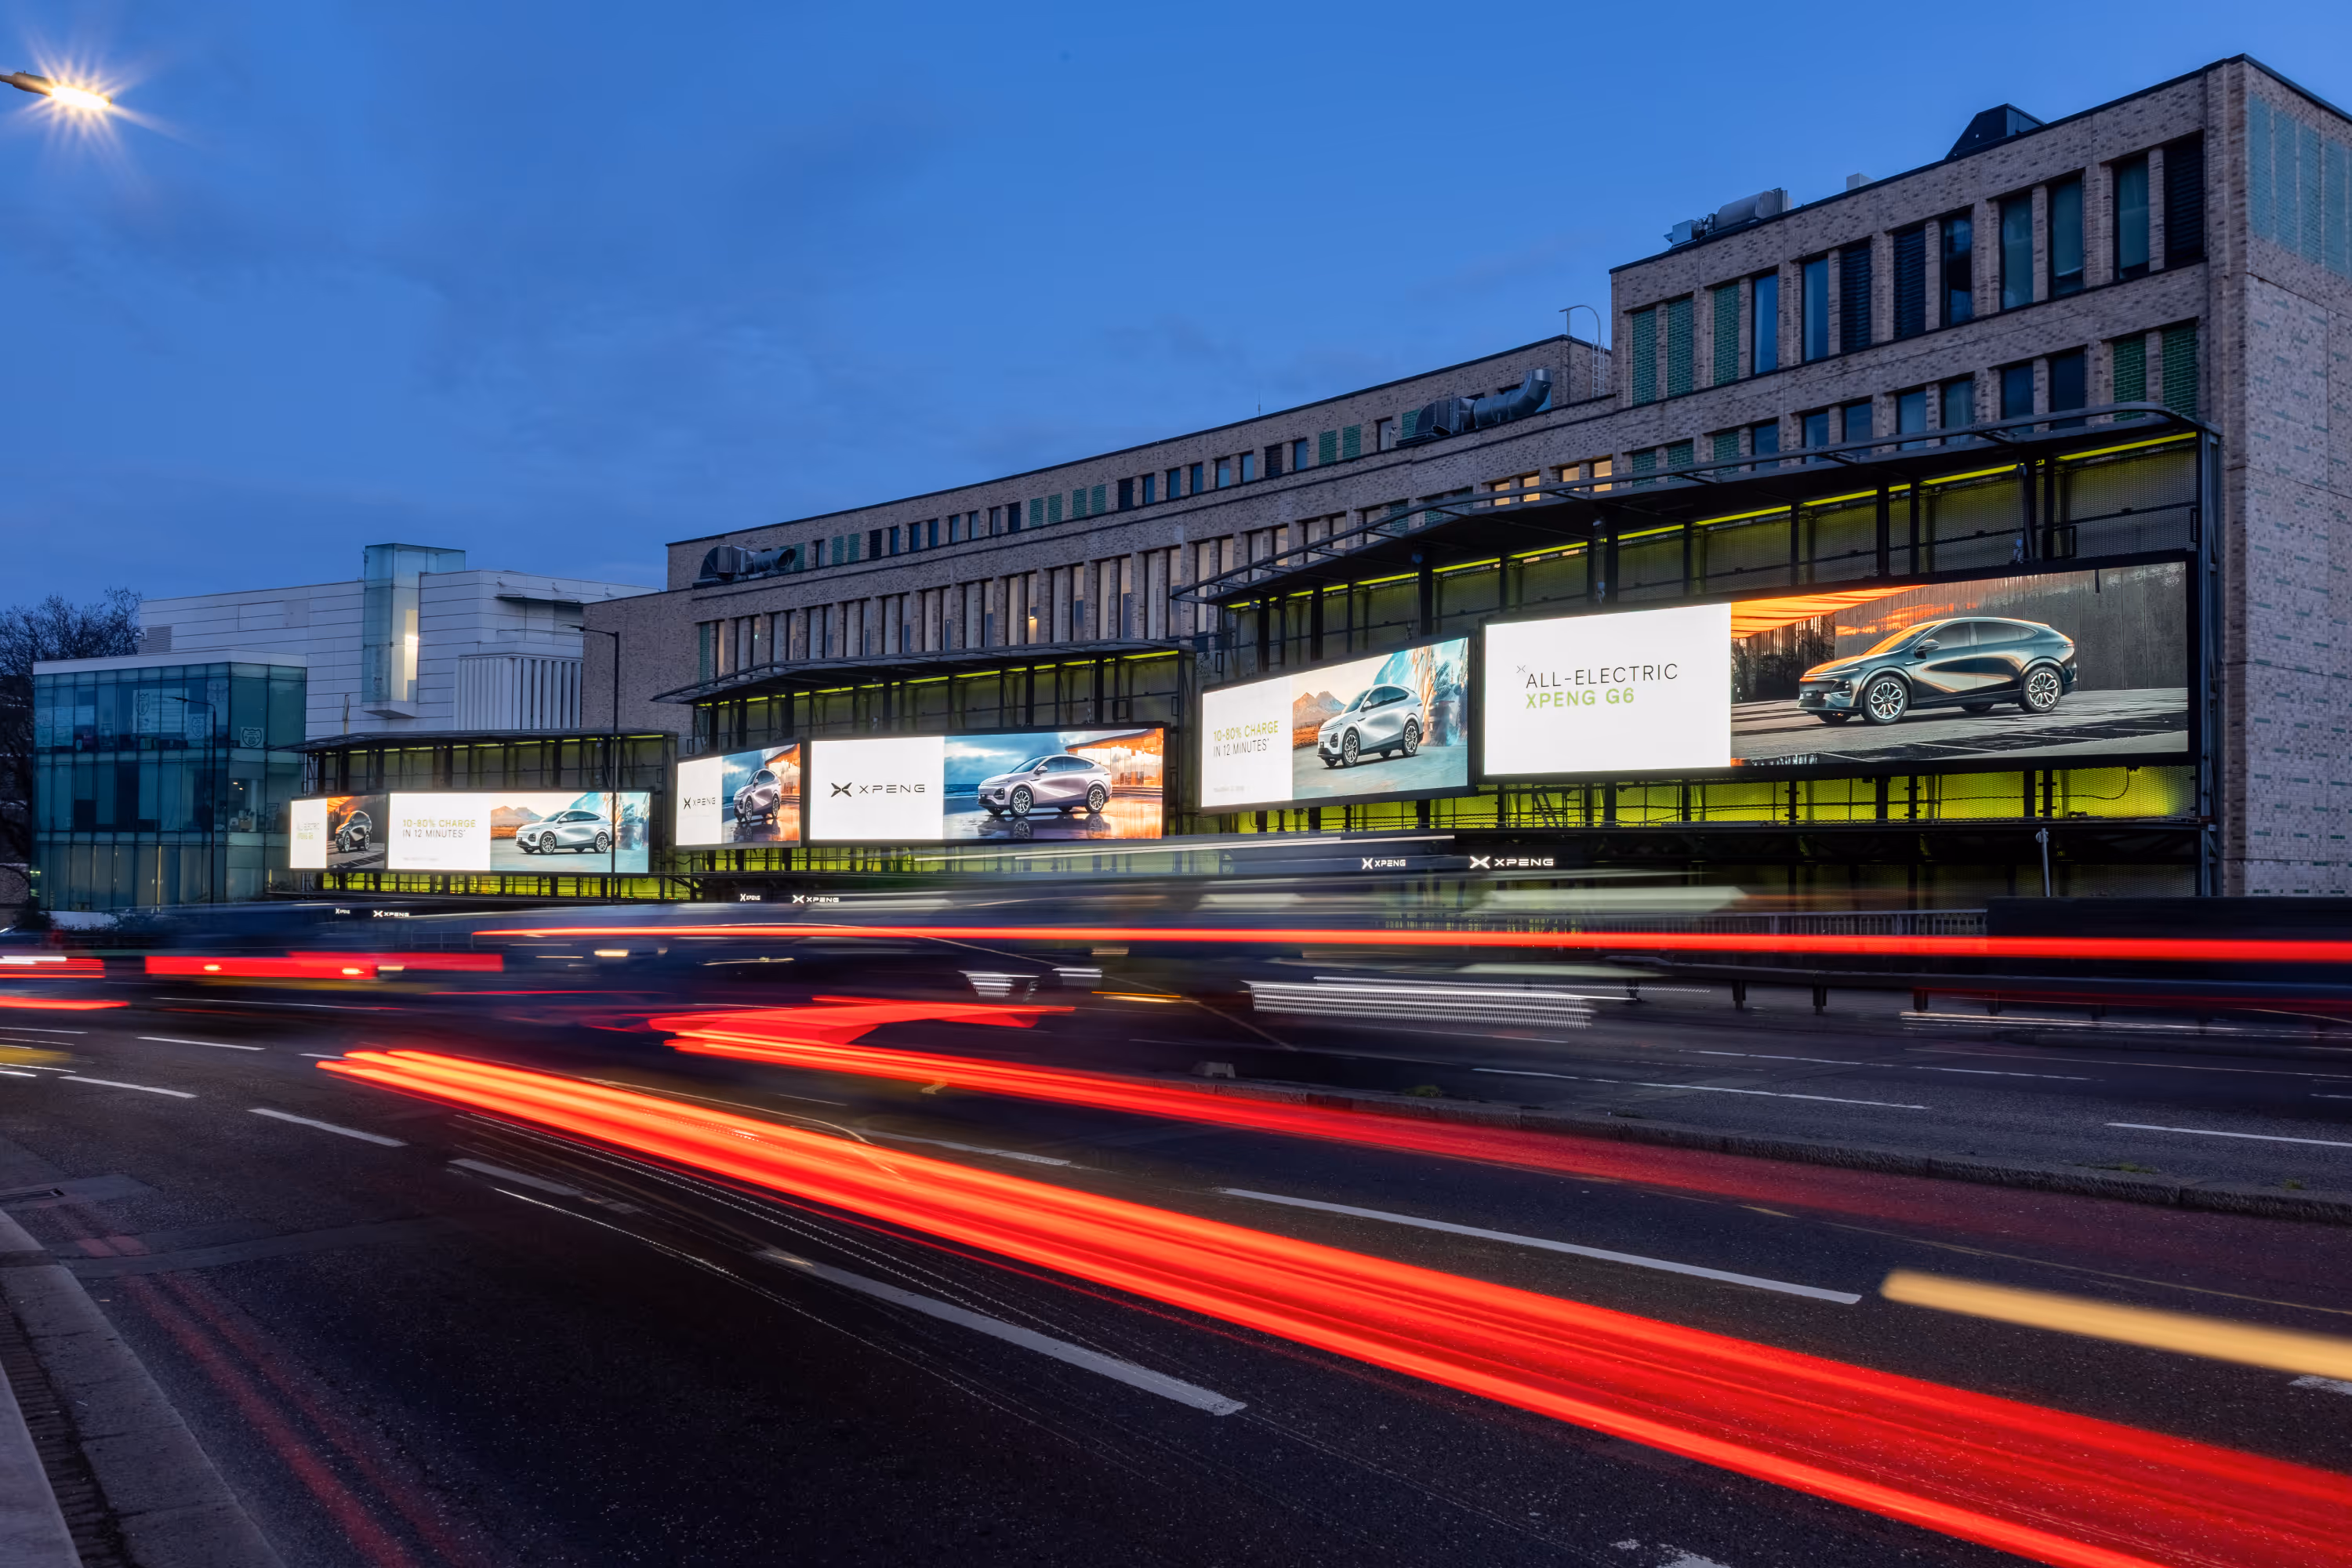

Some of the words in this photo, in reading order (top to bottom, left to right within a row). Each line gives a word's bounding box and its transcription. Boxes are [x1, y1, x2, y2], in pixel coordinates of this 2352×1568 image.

[1526, 663, 1678, 688] ALL-ELECTRIC
[1526, 690, 1595, 709] XPENG
[1606, 688, 1635, 704] G6
[1214, 727, 1242, 742] 10-80%
[1244, 720, 1279, 738] CHARGE
[1213, 746, 1221, 757] IN
[1223, 744, 1230, 757] 12
[859, 784, 925, 794] XPENG
[692, 797, 716, 807] XPENG
[402, 818, 436, 828] 10-80%
[438, 819, 477, 828] CHARGE
[402, 829, 411, 837] IN
[414, 829, 423, 837] 12
